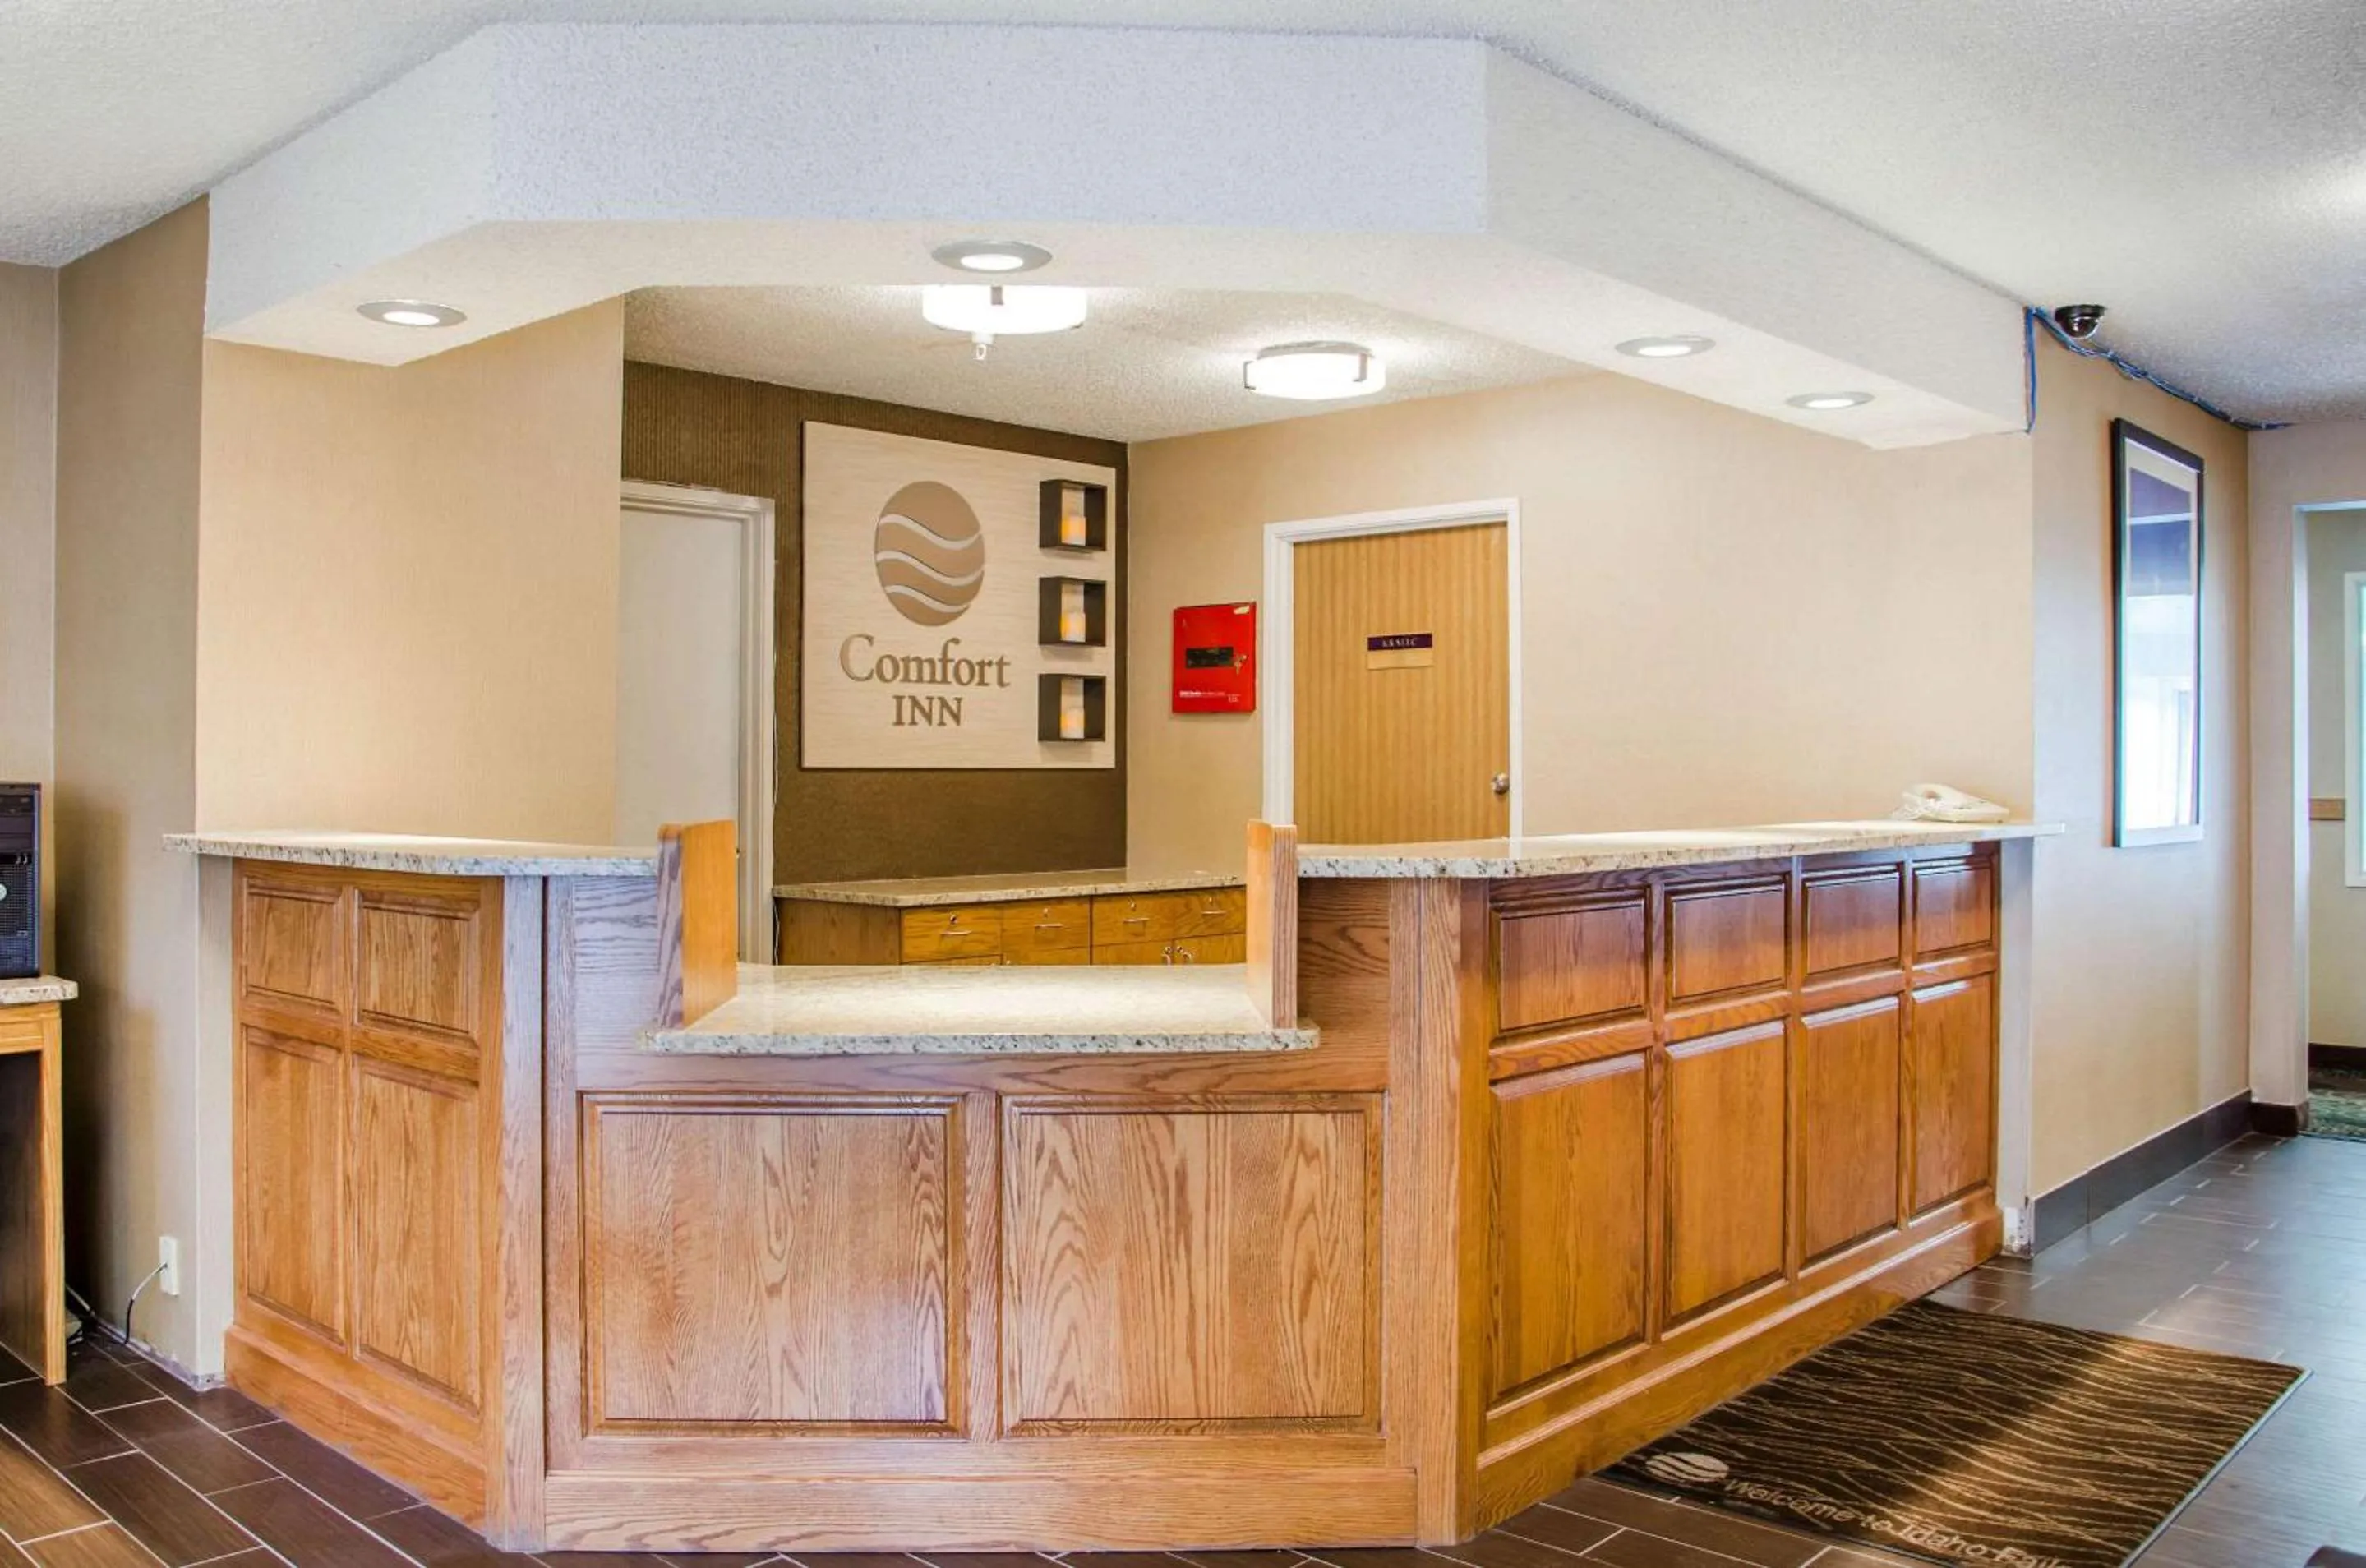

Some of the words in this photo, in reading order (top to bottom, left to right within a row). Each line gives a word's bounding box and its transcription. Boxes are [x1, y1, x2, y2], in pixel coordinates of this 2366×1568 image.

[839, 634, 1011, 688] Comfort
[892, 695, 963, 726] INN
[1725, 1478, 1856, 1521] Welcome
[1860, 1515, 1893, 1531] to
[1899, 1517, 1988, 1558] Idaho
